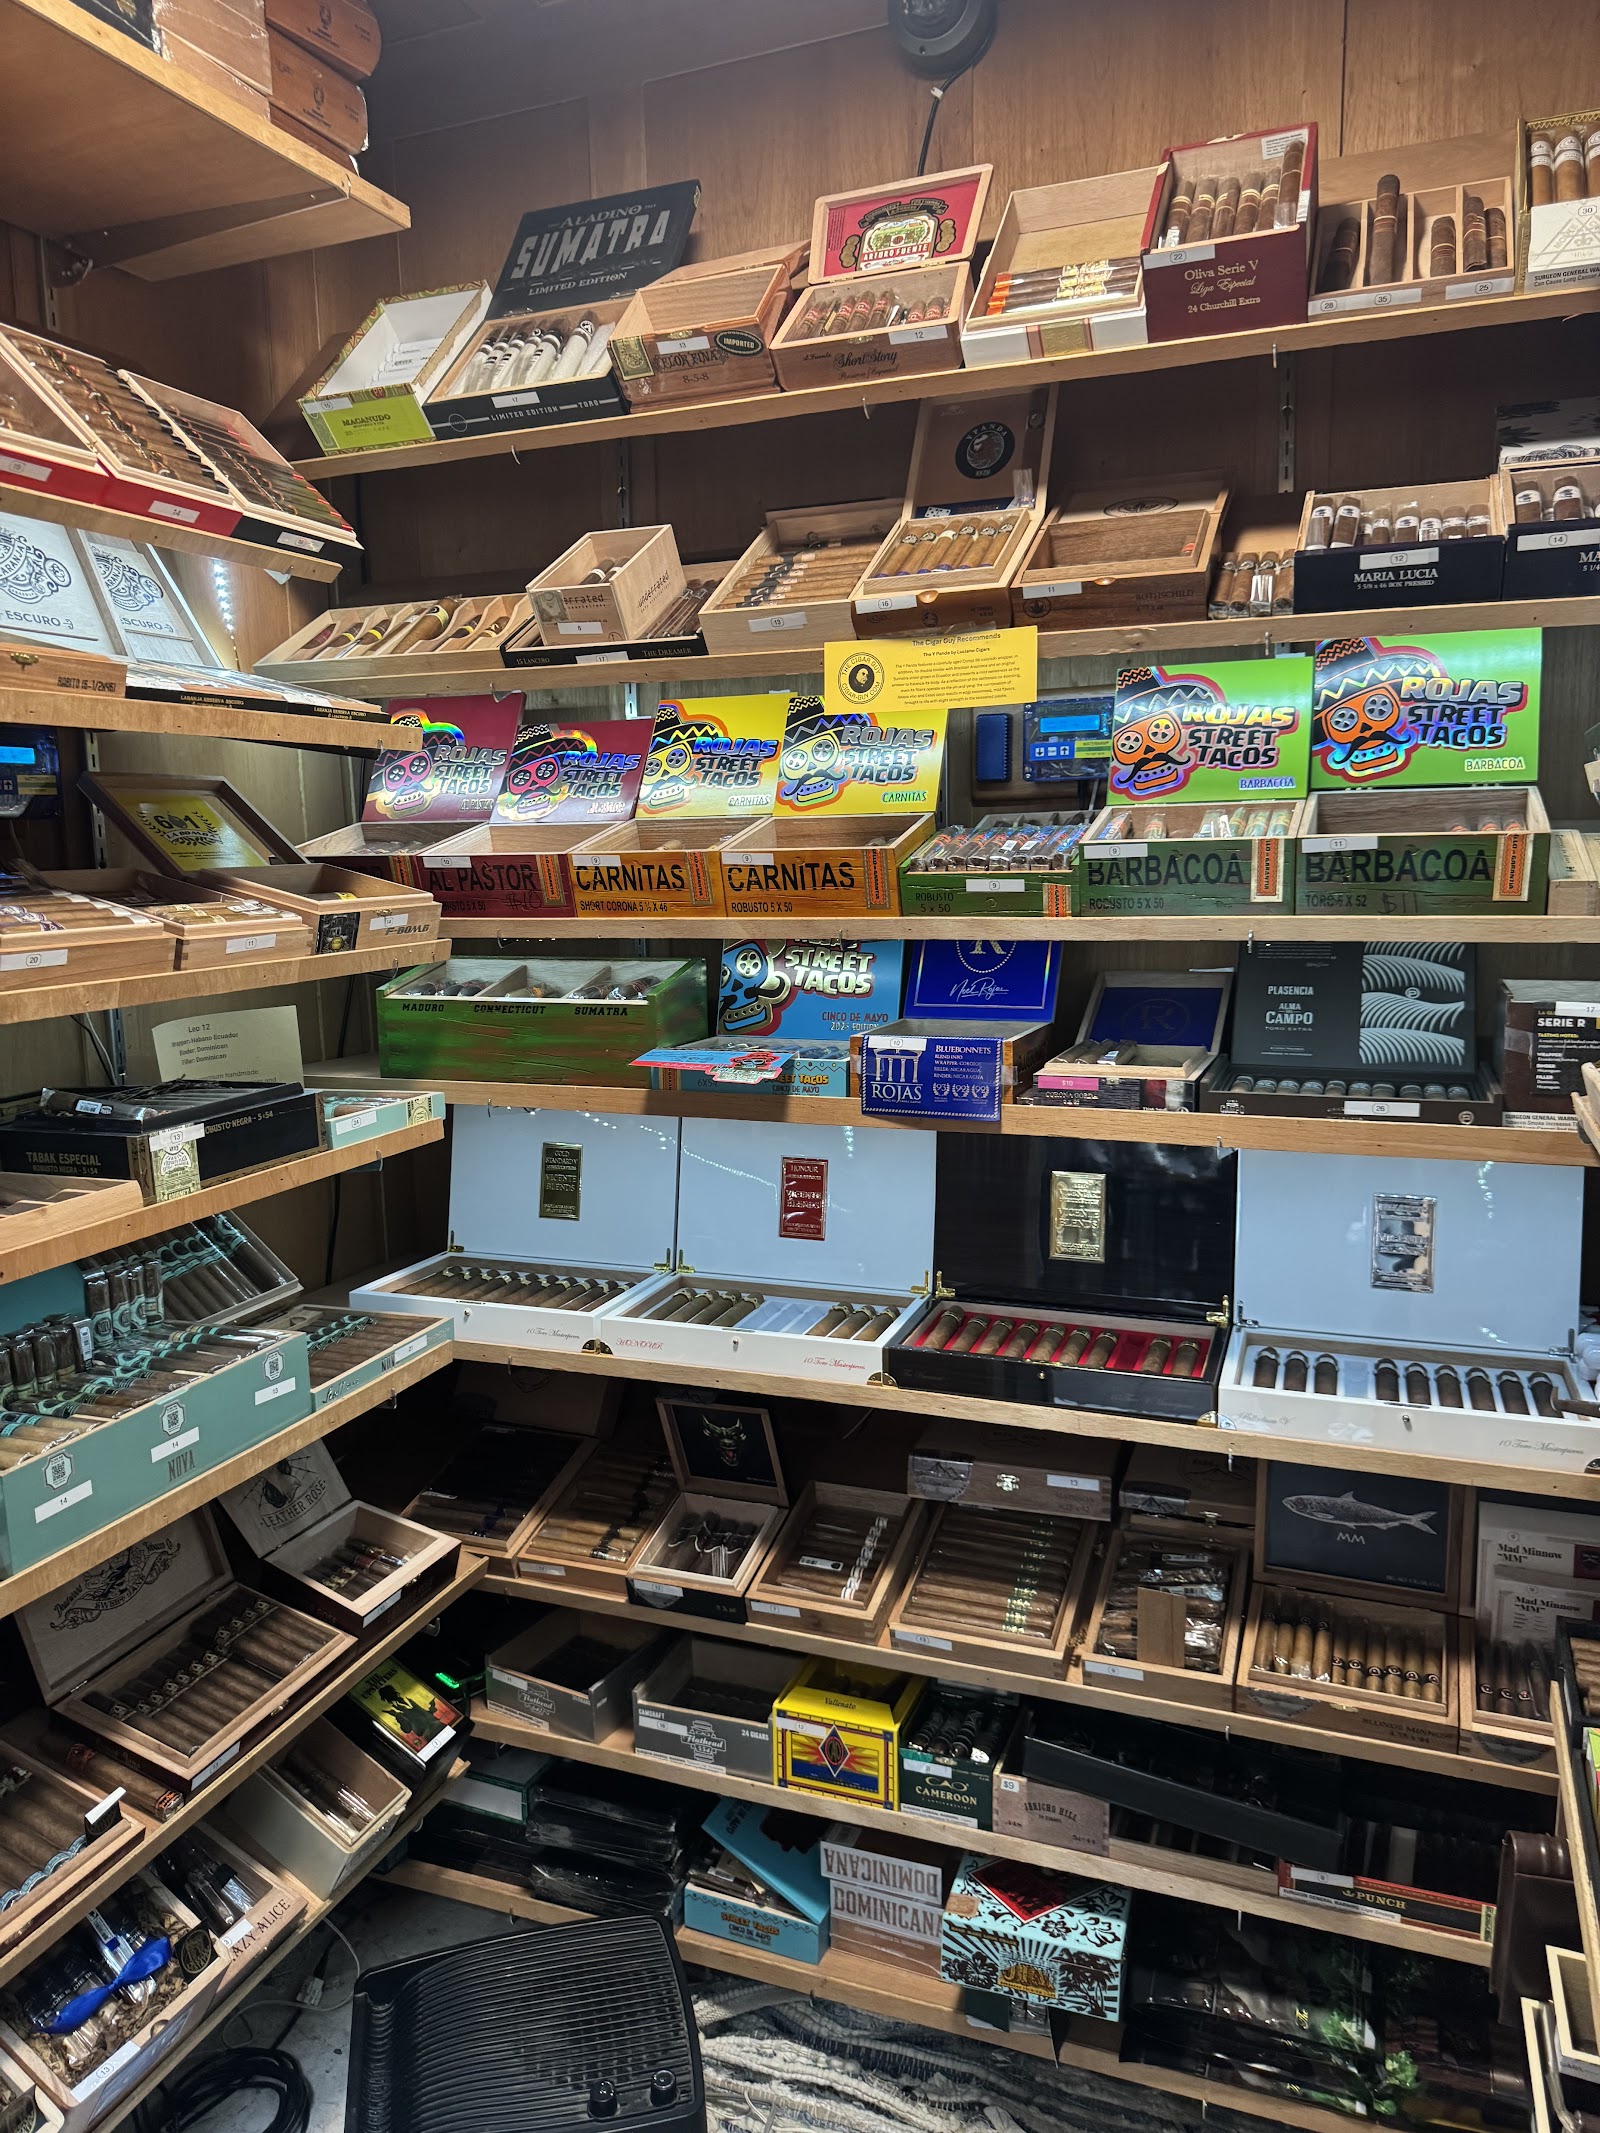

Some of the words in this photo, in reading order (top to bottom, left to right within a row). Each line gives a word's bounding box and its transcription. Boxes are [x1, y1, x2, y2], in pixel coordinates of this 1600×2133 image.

[559, 205, 643, 228] ALADINO
[1582, 207, 1593, 215] 30
[510, 210, 671, 279] SUMATRA
[862, 250, 893, 261] ARTURO
[895, 243, 929, 255] FUENTE
[1184, 266, 1215, 281] Oliva
[1217, 263, 1246, 276] Serie
[1248, 259, 1259, 270] V
[528, 281, 576, 296] LIMITED
[579, 272, 628, 287] EDITION
[1480, 284, 1489, 292] 25
[1187, 303, 1198, 313] 24
[1199, 298, 1238, 312] Churchill
[1238, 295, 1261, 306] Extra
[724, 337, 756, 349] IMPORTED
[683, 373, 709, 384] 8-5-8
[491, 406, 525, 421] LIMITED
[527, 402, 559, 416] EDITION
[579, 400, 600, 409] TORO
[342, 414, 391, 427] MACANUDO
[1354, 571, 1393, 582] MARIA
[1399, 569, 1438, 580] LUCIA
[5, 610, 61, 627] ESCURO
[925, 638, 942, 648] Cigar
[943, 637, 956, 646] Guy
[957, 633, 1001, 643] Recommends
[658, 648, 691, 657] DREAMER
[1401, 677, 1524, 705] ROJAS
[1183, 704, 1296, 727] ROJAS
[1407, 704, 1504, 726] STREET
[841, 725, 934, 748] ROJAS
[1187, 728, 1277, 747] STREET
[1418, 723, 1505, 747] TACOS
[693, 738, 779, 757] ROJAS
[1197, 744, 1276, 766] TACOS
[434, 744, 507, 768] ROJAS
[562, 750, 641, 770] ROJAS
[844, 748, 918, 765] STREET
[1466, 758, 1524, 770] BARBACOA
[434, 764, 494, 780] STREET
[694, 756, 762, 773] STREET
[562, 769, 625, 784] STREET
[700, 771, 762, 788] TACOS
[850, 764, 917, 783] TACOS
[440, 777, 491, 795] TACOS
[566, 781, 623, 799] TACOS
[1240, 777, 1295, 789] BARBACOA
[728, 795, 771, 807] CARNITAS
[882, 791, 927, 803] CARNITAS
[1083, 853, 1243, 886] BARBACOA
[1304, 848, 1491, 882] BARBACOA
[428, 870, 455, 891] AL
[456, 864, 537, 891] PASTOR
[575, 863, 685, 892] CARNITAS
[727, 862, 855, 892] CARNITAS
[914, 889, 953, 899] ROBUSTO
[732, 901, 769, 913] ROBUSTO
[770, 902, 776, 912] 5
[777, 902, 783, 912] X
[784, 902, 793, 912] 50
[920, 902, 926, 910] 5
[938, 902, 950, 910] 50
[1085, 897, 1135, 909] ROBUSTO
[1137, 897, 1143, 908] 5
[1144, 897, 1151, 908] X
[1152, 897, 1164, 908] 50
[29, 956, 39, 964] 20
[785, 946, 874, 973] STREET
[793, 965, 873, 995] TACOS
[1268, 985, 1314, 996] PLASENCIA
[402, 1003, 445, 1013] MADURO
[474, 1004, 546, 1015] CONNECTICUT
[574, 1006, 628, 1017] SUMATRA
[1279, 1002, 1301, 1011] ALMA
[821, 1011, 847, 1021] CINCO
[850, 1012, 861, 1021] DE
[864, 1013, 888, 1023] MAYO
[1265, 1010, 1313, 1025] CAMPO
[1537, 1018, 1574, 1028] SERIE
[1577, 1018, 1586, 1028] R
[188, 1025, 200, 1033] Leo
[197, 1043, 228, 1052] Dominican
[935, 1044, 991, 1055] BLUEBONNETS
[196, 1053, 227, 1063] Dominican
[225, 1069, 259, 1079] handmade
[772, 1085, 790, 1093] CINCO
[802, 1086, 819, 1094] MAYO
[871, 1083, 922, 1103] ROJAS
[1376, 1105, 1385, 1113] 26
[26, 1151, 56, 1163] TABAK
[58, 1152, 102, 1166] ESPECIAL
[790, 1165, 819, 1173] HONOUR
[546, 1183, 576, 1192] BLENDS
[802, 1356, 812, 1365] 10
[813, 1356, 836, 1367] Toro
[837, 1359, 866, 1370] Masterpieces
[263, 1500, 305, 1529] LEATHER
[305, 1480, 327, 1510] ROSE
[1498, 1543, 1520, 1554] Mad
[1521, 1546, 1563, 1559] Minnow
[1515, 1596, 1537, 1606] Mad
[1539, 1600, 1580, 1612] Minnow
[824, 1697, 857, 1711] Vallenato
[741, 1729, 749, 1737] 24
[749, 1730, 769, 1741] CIGARS
[925, 1776, 969, 1792] CAO
[1003, 1781, 1014, 1790] $9
[915, 1785, 978, 1806] CAMEROON
[1024, 1802, 1056, 1813] JERICHO
[1058, 1807, 1077, 1822] HILL
[823, 1848, 939, 1898] DOMINICANA
[1283, 1888, 1308, 1899] SURGEON
[1309, 1894, 1333, 1904] GENERAL
[1334, 1899, 1360, 1910] WARNING
[1356, 1891, 1407, 1910] PUNCH
[832, 1885, 943, 1939] DOMINICANA
[721, 1911, 750, 1926] STREET
[752, 1919, 780, 1936] TACOS
[728, 1924, 746, 1934] CINCO
[754, 1929, 771, 1940] MAYO
[100, 2065, 112, 2076] 13
